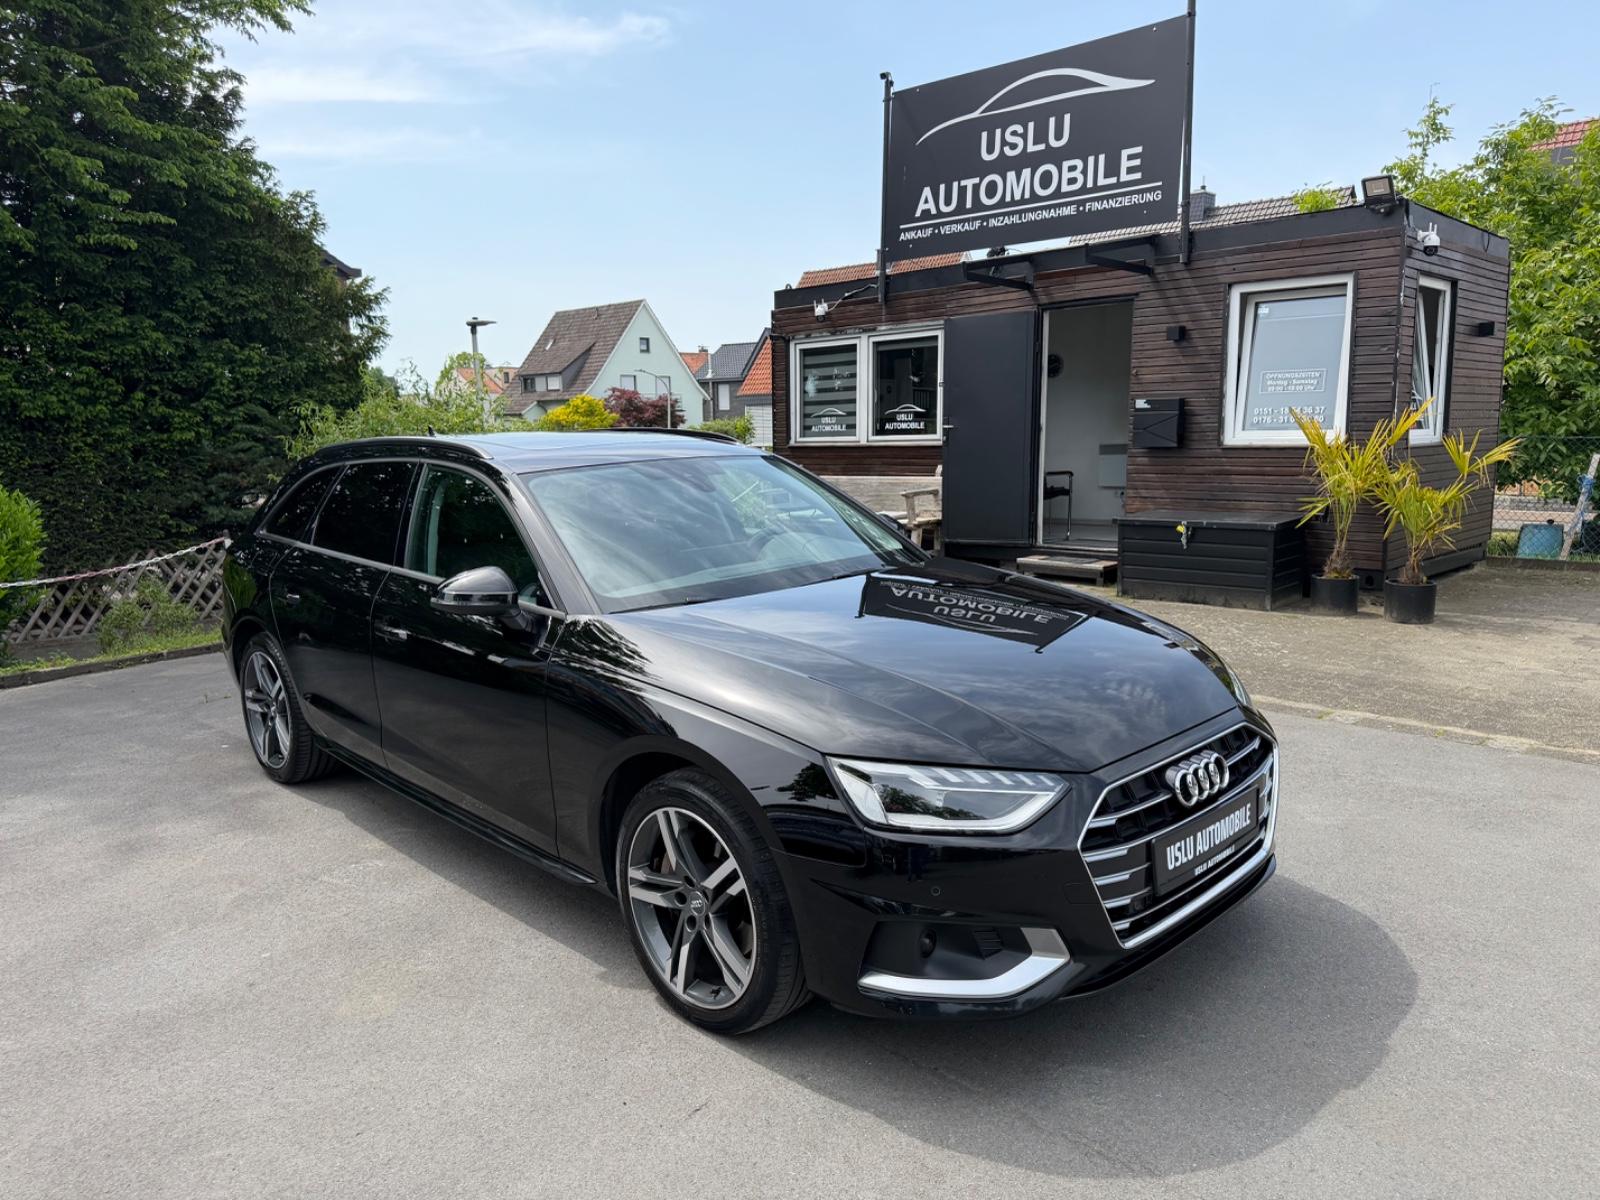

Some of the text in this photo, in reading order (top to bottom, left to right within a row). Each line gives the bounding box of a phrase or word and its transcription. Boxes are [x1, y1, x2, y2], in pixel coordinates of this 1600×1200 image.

[980, 113, 1071, 161] USLU
[914, 146, 1143, 217] AUTOMOBILE
[899, 190, 1162, 241] ANKAUF VERKAUF INZAHLUNGNAHME FINANZIERUNG
[811, 424, 846, 432] AUTOMOBILE
[821, 416, 836, 424] USLU
[885, 421, 925, 430] AUTOMOBILE
[896, 413, 913, 421] USLU
[1166, 803, 1251, 871] USLU AUTOMOBILE
